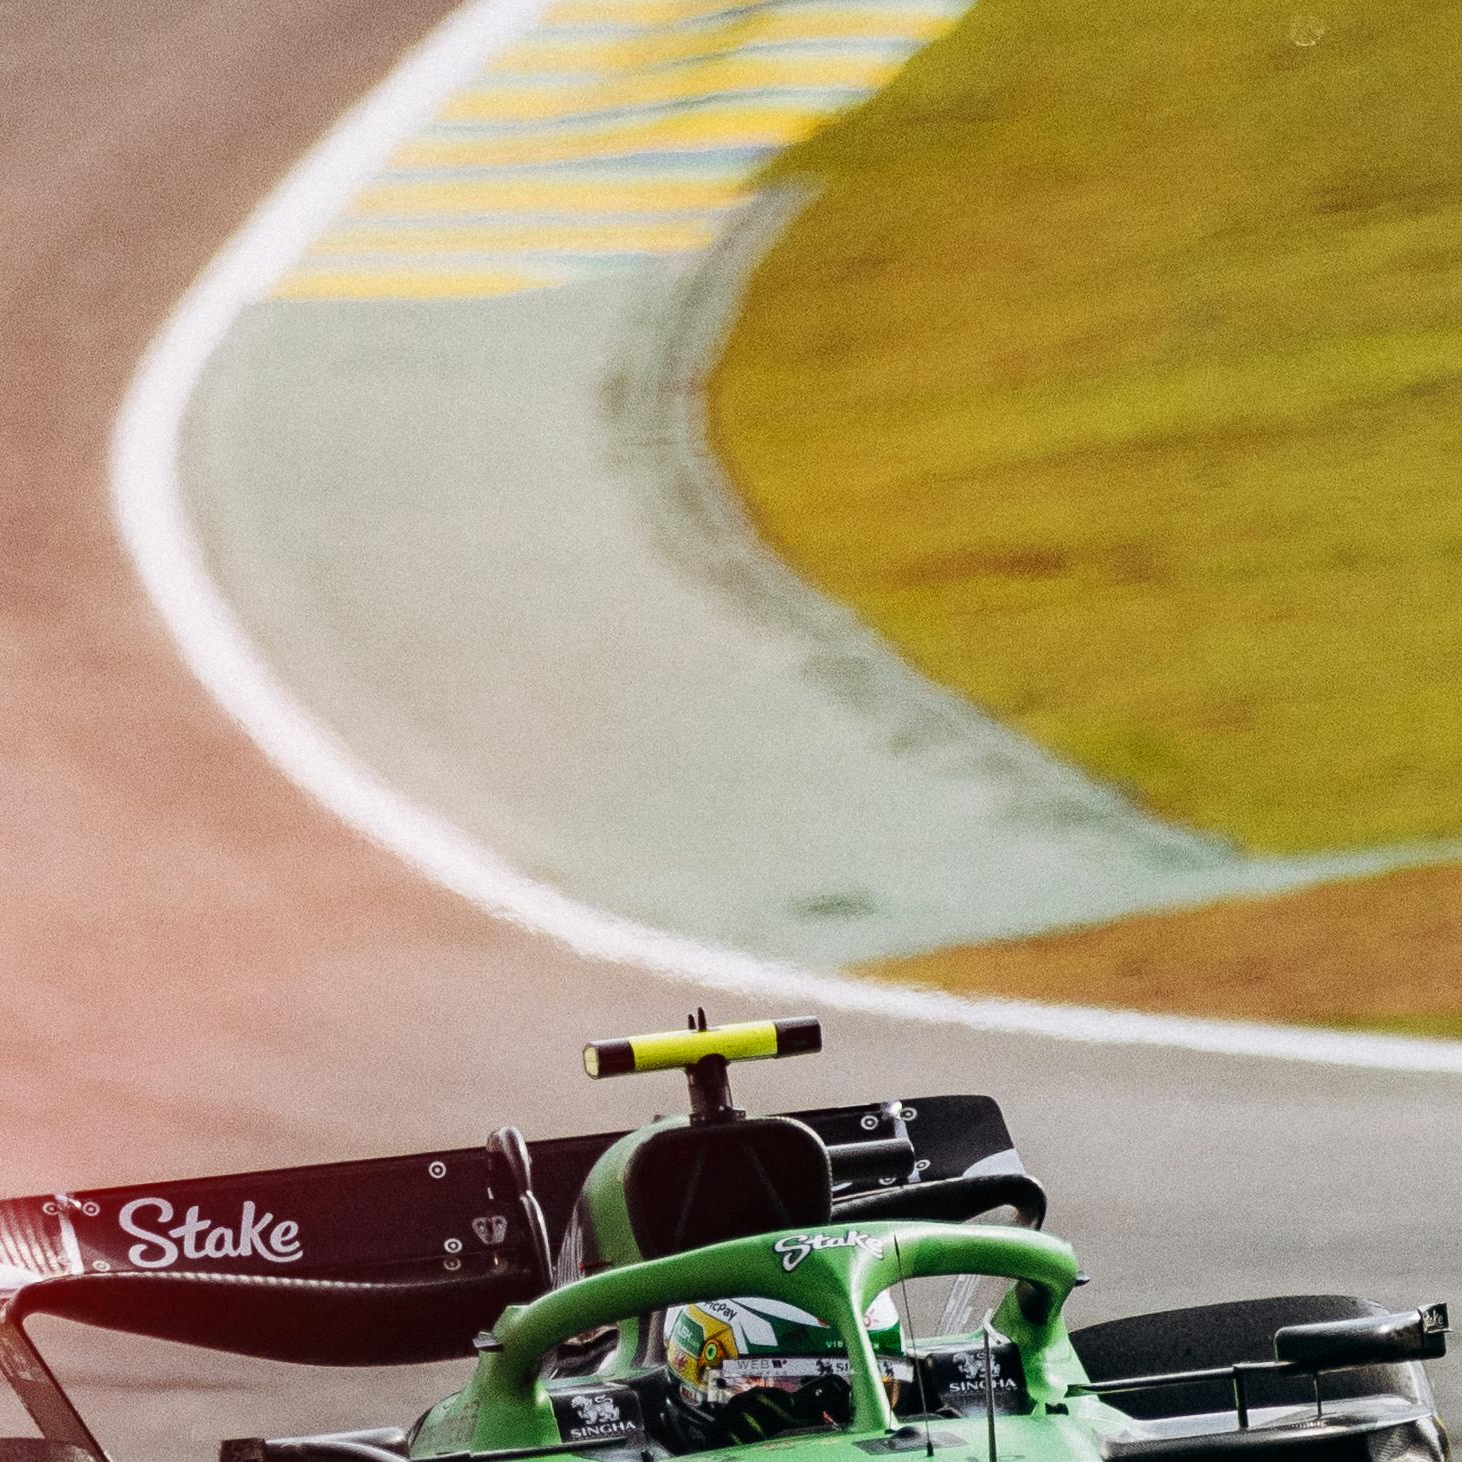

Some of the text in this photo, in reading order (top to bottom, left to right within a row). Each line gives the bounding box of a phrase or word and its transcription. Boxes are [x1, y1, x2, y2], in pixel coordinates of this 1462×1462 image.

[118, 1197, 304, 1268] Stake
[774, 1230, 885, 1272] Stake
[738, 1360, 770, 1370] WEB
[949, 1378, 1018, 1393] SINGHA
[570, 1420, 637, 1440] SINGHA
